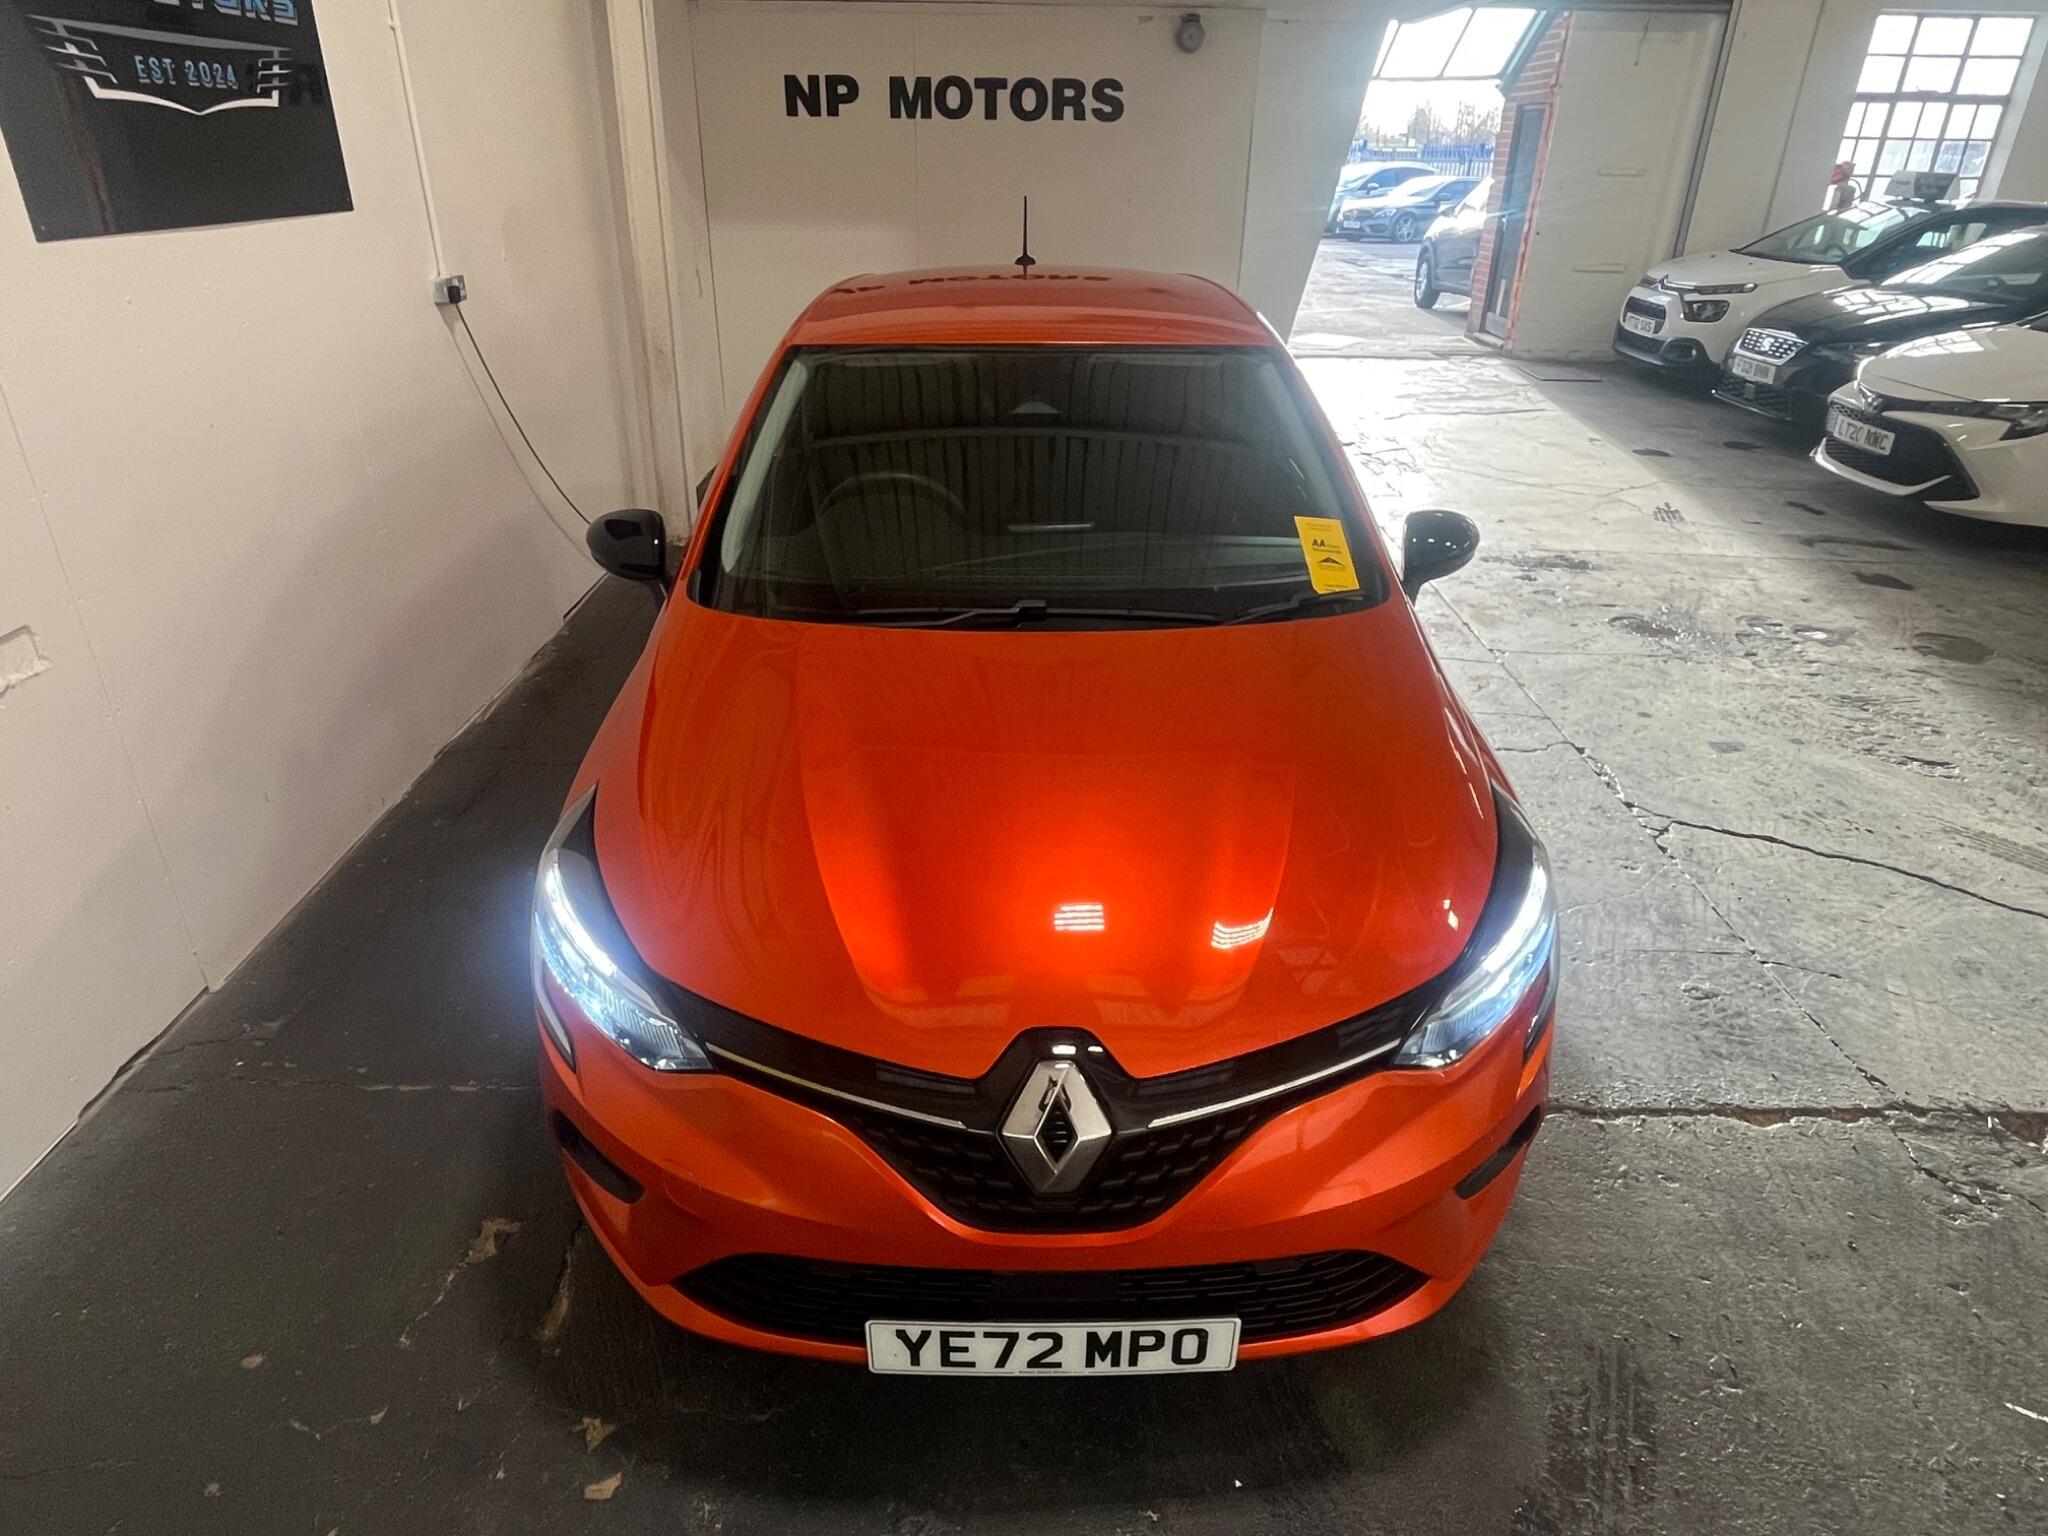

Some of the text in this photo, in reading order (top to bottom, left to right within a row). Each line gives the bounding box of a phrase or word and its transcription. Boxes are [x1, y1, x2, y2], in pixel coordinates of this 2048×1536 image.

[134, 55, 239, 89] EST 2024
[784, 74, 1125, 123] NP MOTORS
[895, 1328, 1208, 1368] YE72 MPO
